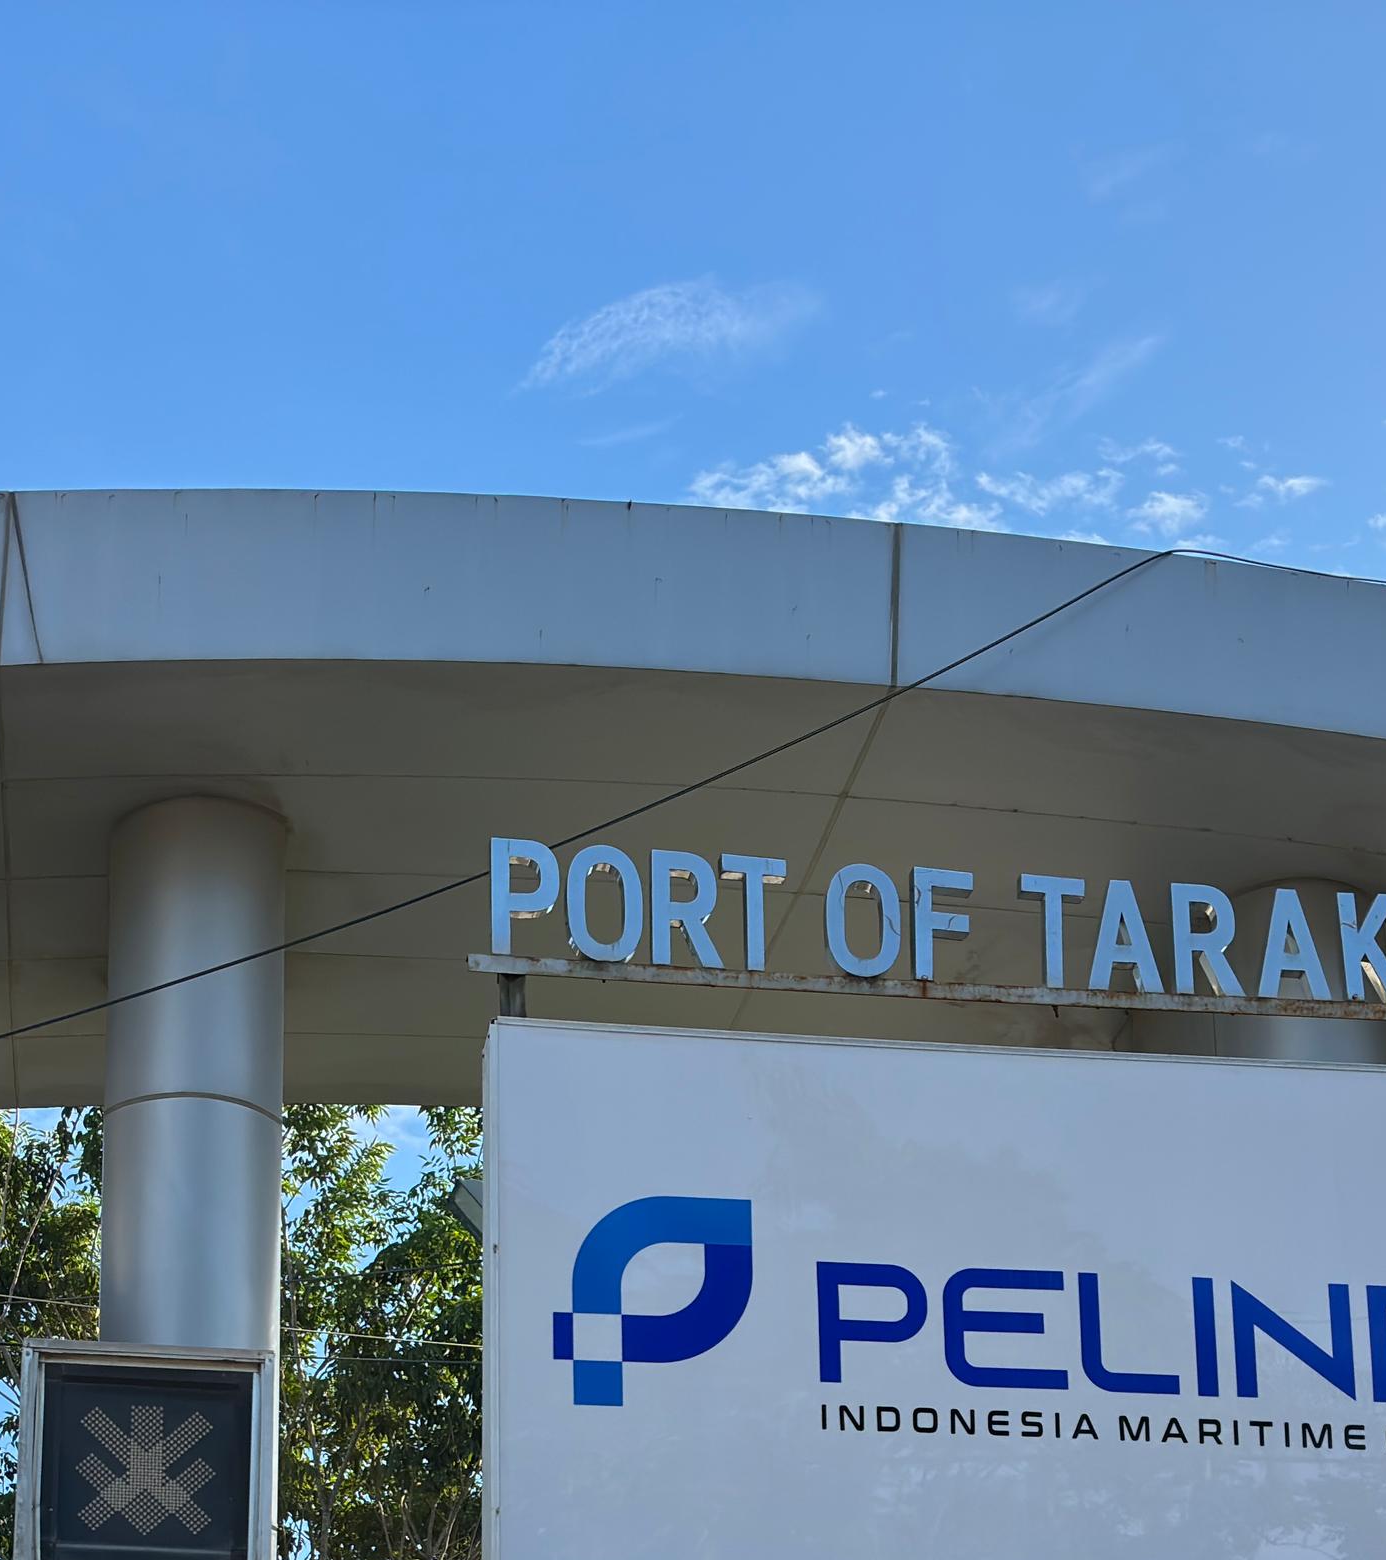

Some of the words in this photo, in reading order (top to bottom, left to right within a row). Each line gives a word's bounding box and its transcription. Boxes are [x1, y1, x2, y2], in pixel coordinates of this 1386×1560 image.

[490, 836, 787, 971] PORT
[824, 862, 974, 981] OF
[820, 1403, 1099, 1442] INDONESIA
[1119, 1414, 1368, 1452] MARITIME
